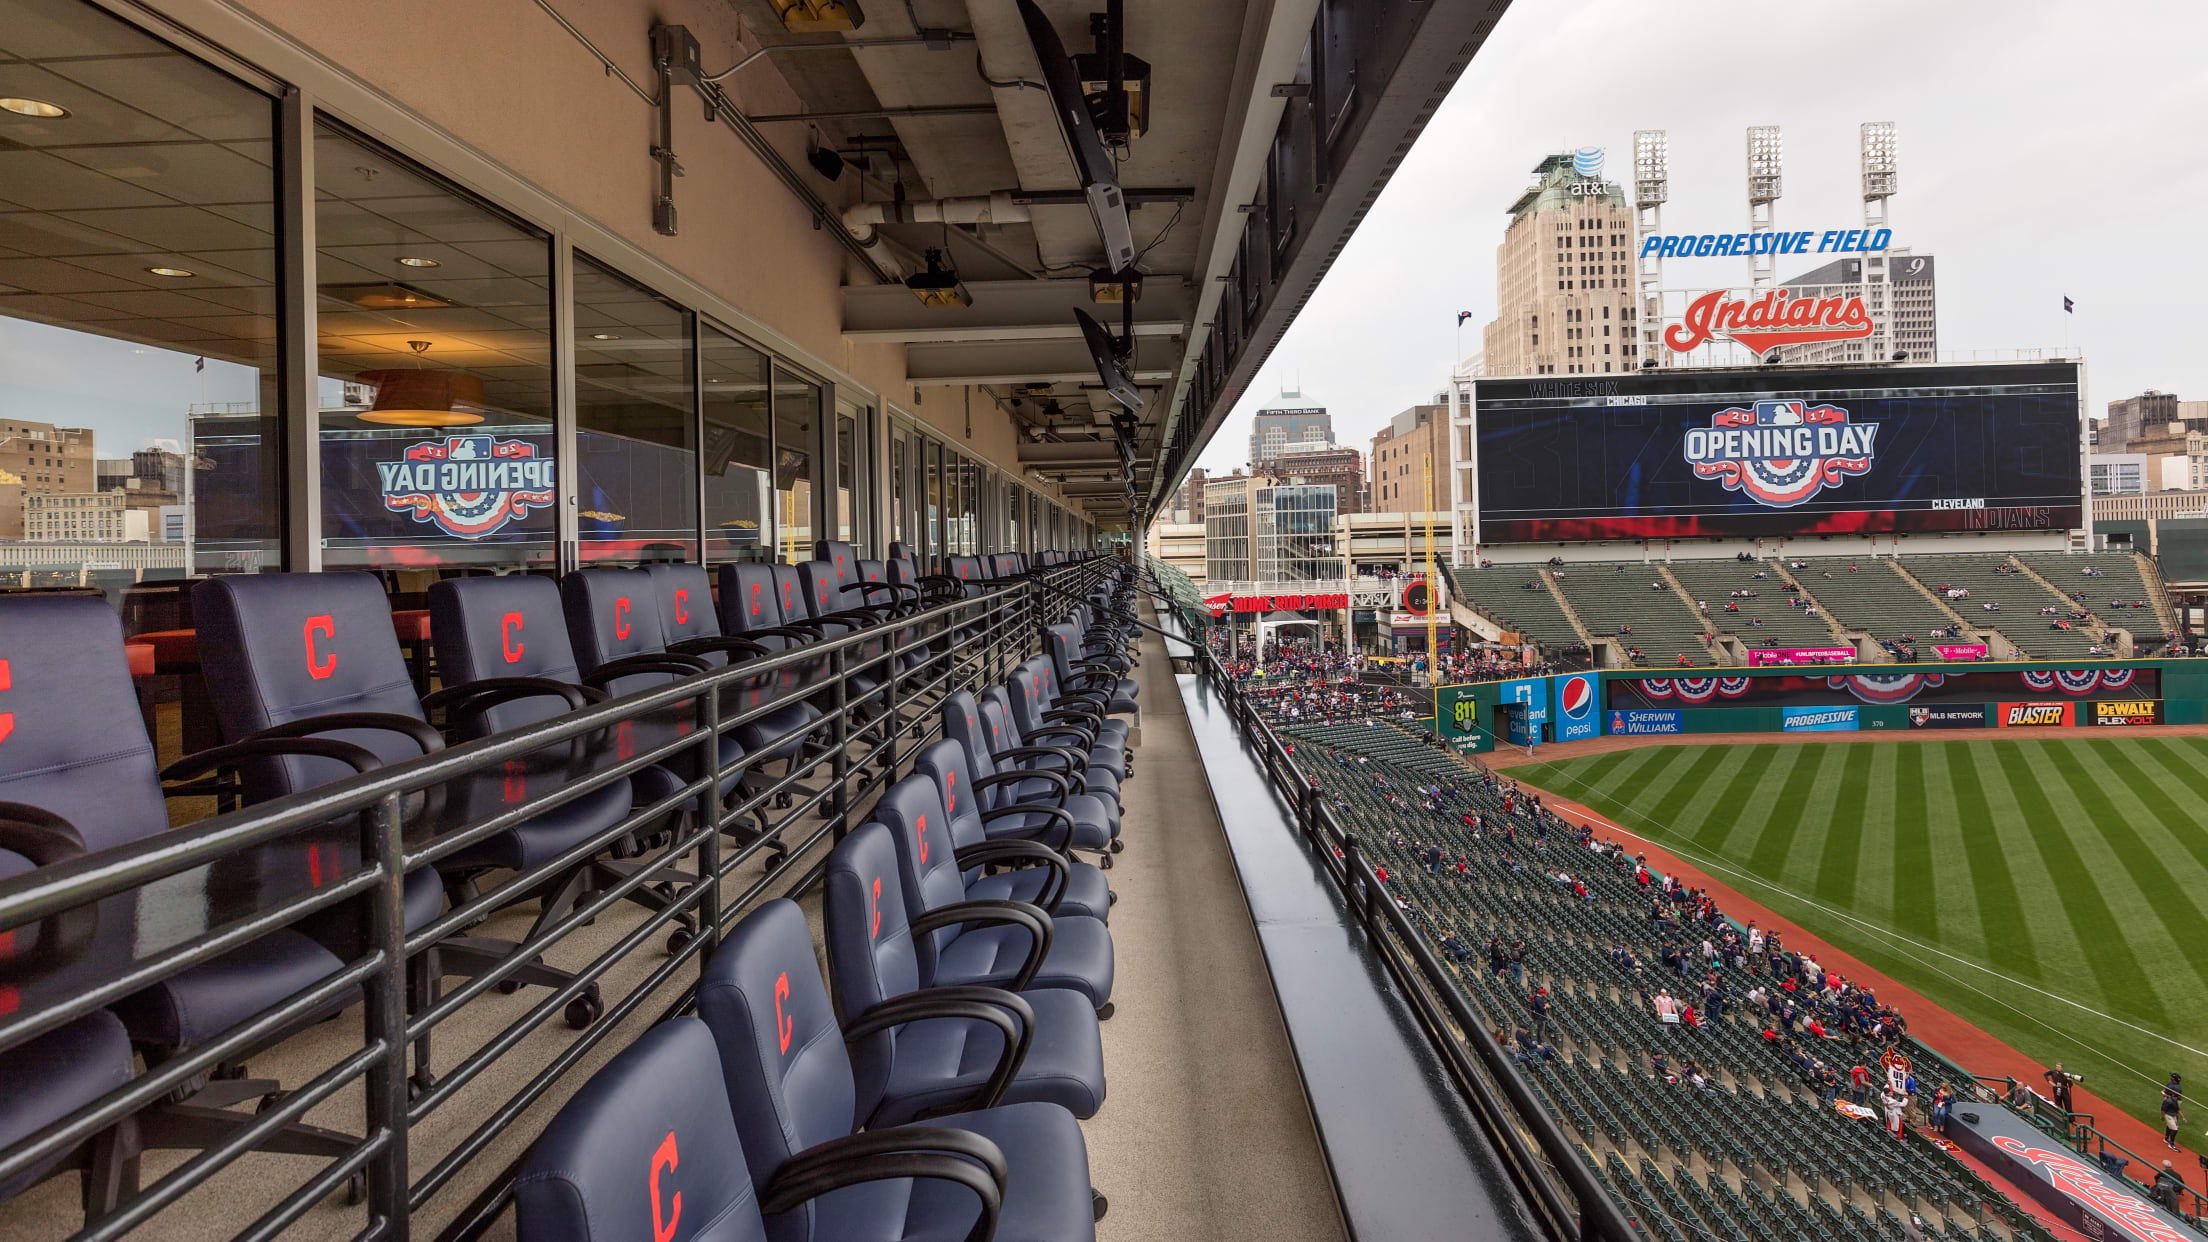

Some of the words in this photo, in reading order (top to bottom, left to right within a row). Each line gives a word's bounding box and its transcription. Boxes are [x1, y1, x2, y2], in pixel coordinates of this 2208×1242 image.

[1571, 180, 1609, 195] at&t
[1640, 231, 1814, 258] PROGRESSIVE
[1818, 228, 1893, 252] FIELD
[1664, 289, 1874, 353] Indians
[1529, 384, 1581, 399] WHITE
[1585, 381, 1619, 396] SOX
[1606, 395, 1647, 407] CHICAGO
[1732, 411, 1750, 422] 20
[1810, 409, 1826, 421] 17
[1687, 427, 1813, 459] OPENING
[1818, 425, 1875, 455] DAY
[1932, 498, 1985, 509] CLEVELAND
[1964, 507, 2050, 528] INDIANS
[676, 589, 688, 625] C
[752, 584, 760, 615] C
[1233, 596, 1272, 612] HOME
[1274, 595, 1301, 611] RUN
[1304, 594, 1349, 610] PORCH
[616, 597, 631, 640] C
[304, 615, 337, 681] C
[502, 612, 523, 663] C
[1455, 701, 1476, 721] 811
[1628, 711, 1675, 722] SHERWIN
[1784, 710, 1857, 727] PROGRESSIVE
[1947, 711, 1984, 719] NETWORK
[2098, 717, 2155, 725] FLEXVOLT
[1567, 722, 1591, 738] pepsi
[918, 815, 929, 865] C
[872, 877, 881, 939] C
[776, 971, 793, 1056] C
[649, 1130, 682, 1242] C
[1990, 1136, 2193, 1242] Indian
